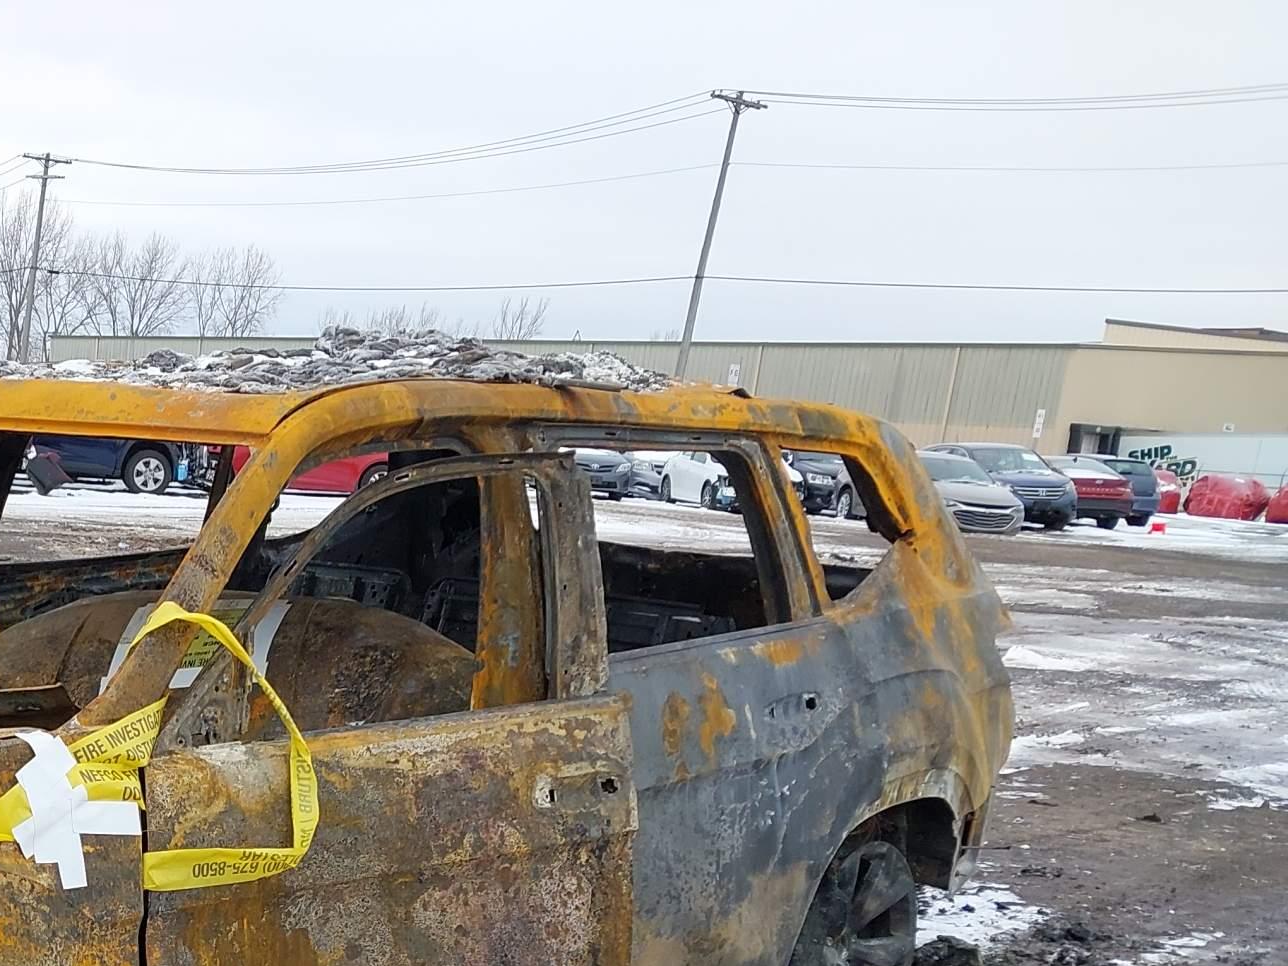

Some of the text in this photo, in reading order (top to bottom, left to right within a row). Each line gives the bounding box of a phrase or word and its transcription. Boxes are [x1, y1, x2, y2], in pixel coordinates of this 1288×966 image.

[1127, 444, 1172, 460] SHIP
[73, 738, 108, 765] FIRE
[79, 769, 124, 784] NEFCO
[192, 860, 259, 878] 675-8500
